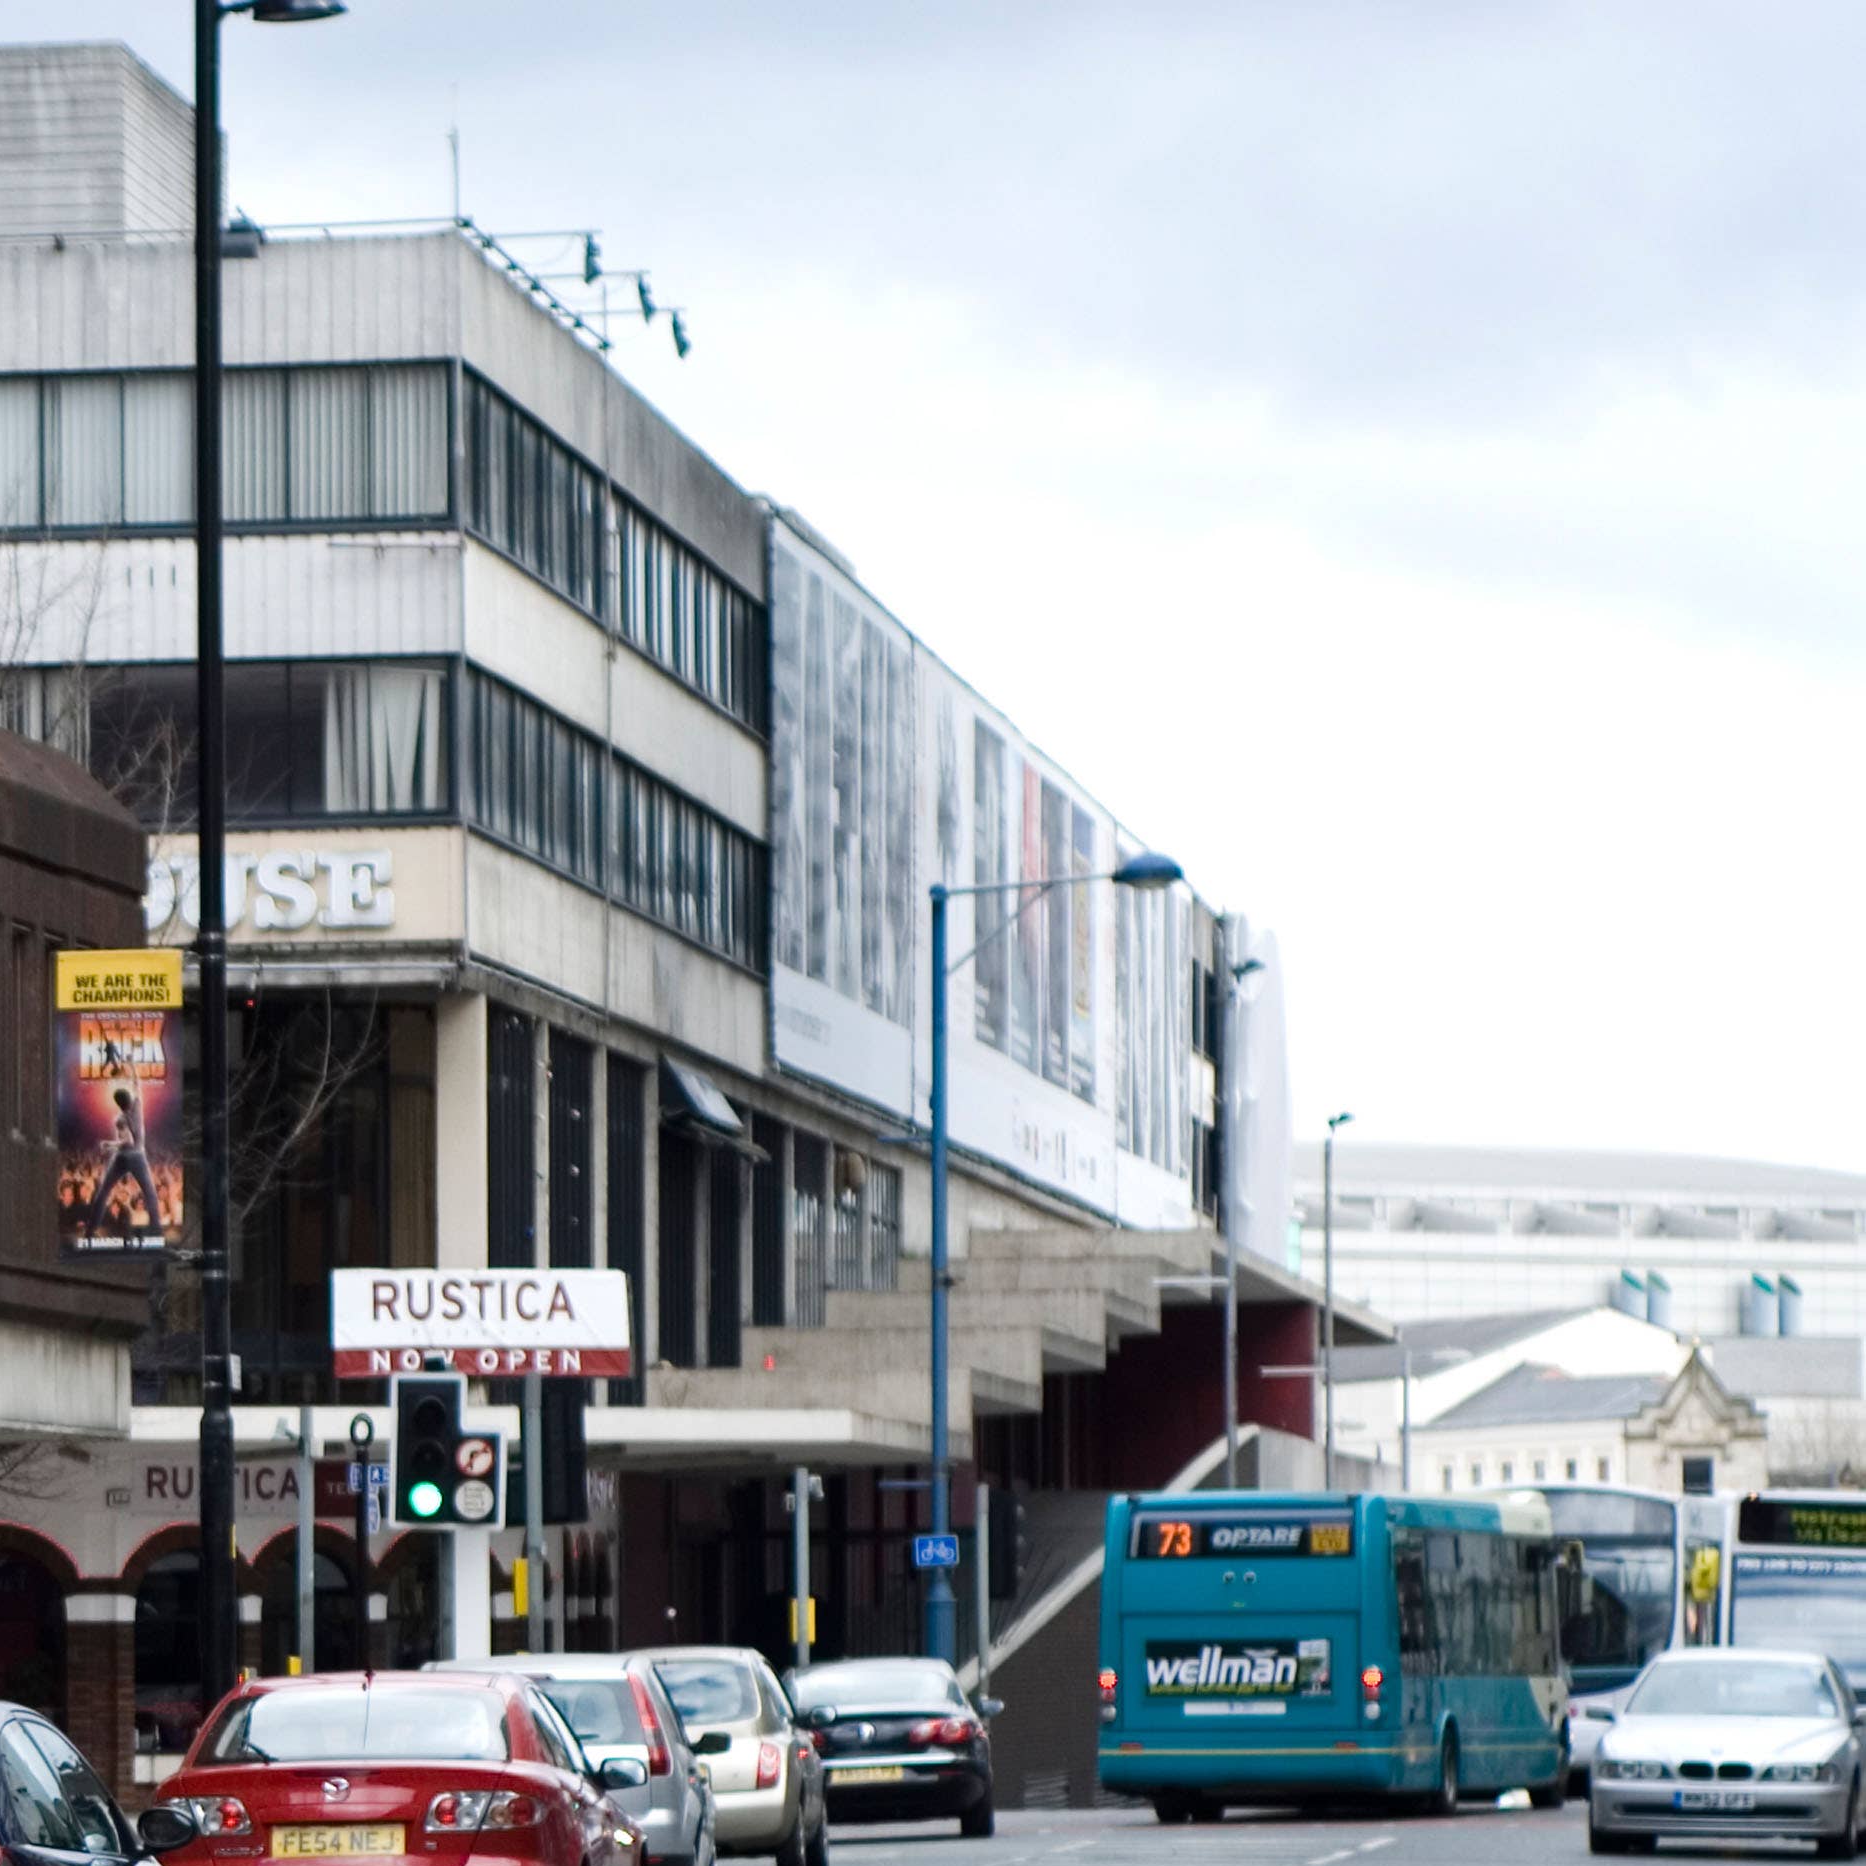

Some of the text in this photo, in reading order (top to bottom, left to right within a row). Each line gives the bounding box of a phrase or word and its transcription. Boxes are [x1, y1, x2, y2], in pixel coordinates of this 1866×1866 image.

[75, 973, 168, 987] WE ARE THE
[73, 989, 170, 1002] CHAMPIONS!
[372, 1280, 576, 1322] RUSTICA
[479, 1350, 581, 1372] OPEN
[1159, 1523, 1192, 1557] 73
[1212, 1527, 1303, 1549] OPTARE
[1147, 1645, 1298, 1686] wellman
[283, 1832, 342, 1854] FE54
[349, 1831, 395, 1852] NEJ
